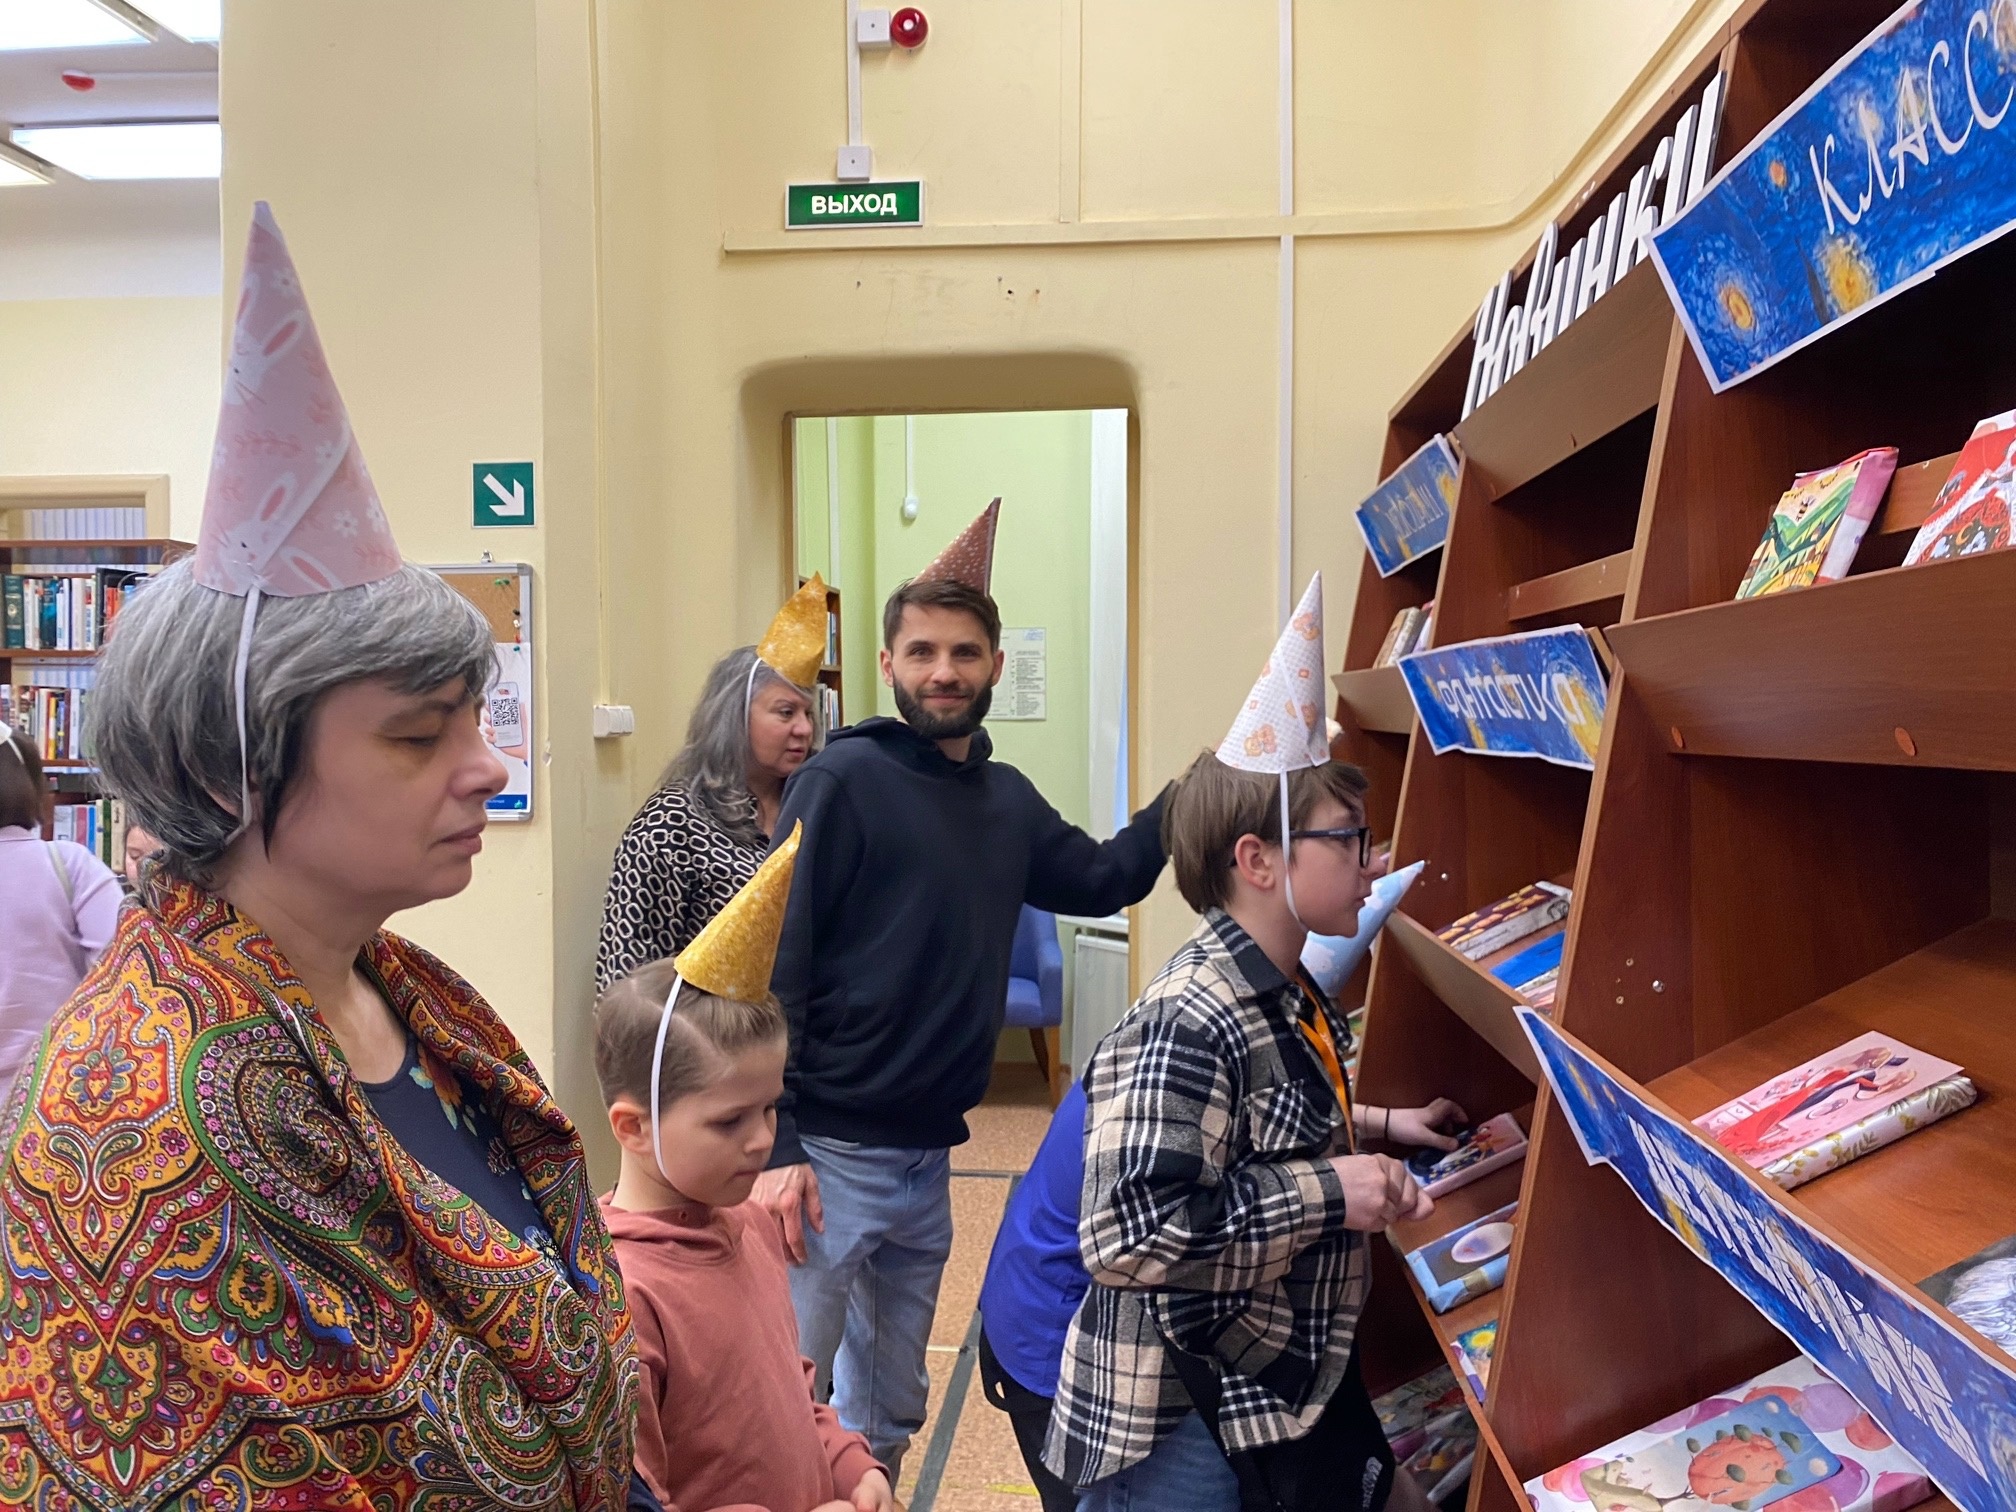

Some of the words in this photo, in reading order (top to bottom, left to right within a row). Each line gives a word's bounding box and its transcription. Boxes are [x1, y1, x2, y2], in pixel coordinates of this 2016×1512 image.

[811, 193, 898, 216] ВЫХОД
[1809, 0, 2016, 235] КЛАСС
[1627, 1114, 1991, 1483] ДЕТЕКТИВ
